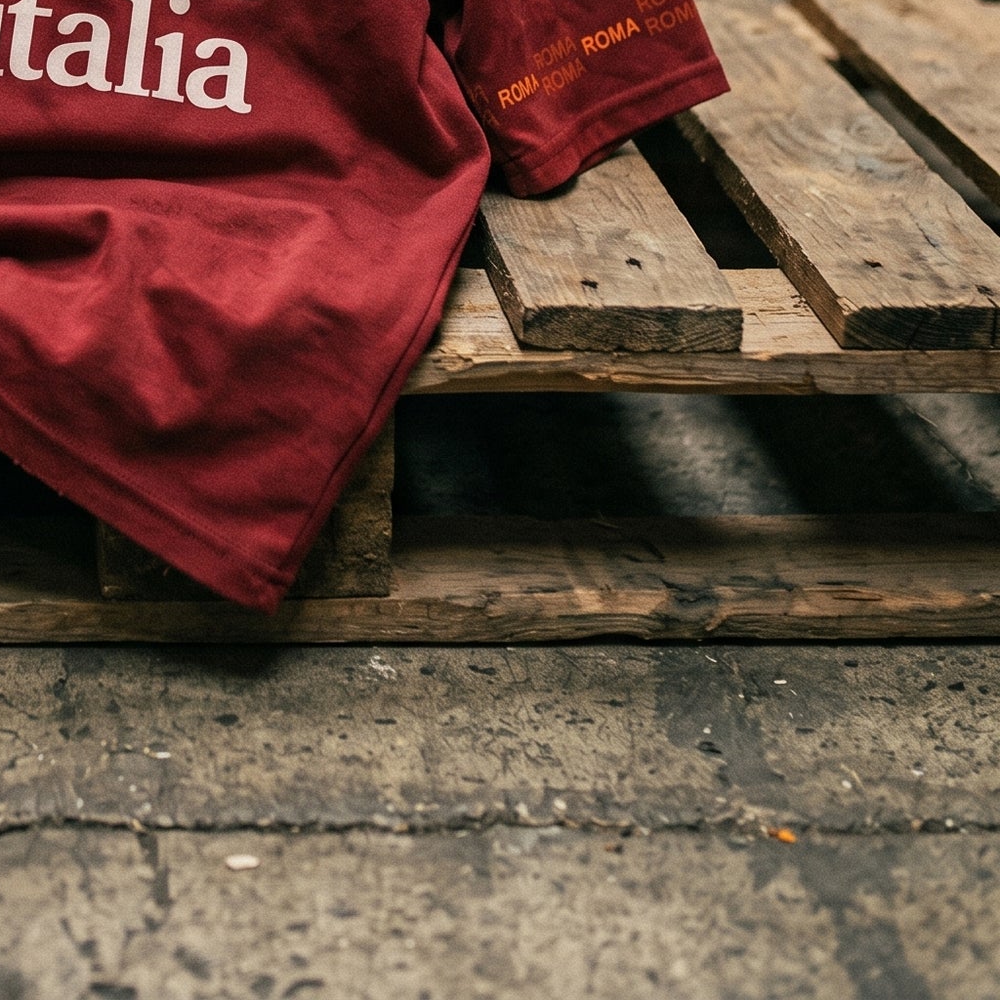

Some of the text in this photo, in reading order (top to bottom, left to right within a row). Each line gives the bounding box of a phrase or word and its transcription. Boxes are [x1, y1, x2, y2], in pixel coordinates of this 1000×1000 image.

[581, 17, 640, 56] ROMA
[644, 1, 695, 36] ROM
[533, 36, 577, 70] ROMA
[497, 73, 540, 109] ROMA
[541, 58, 587, 96] ROMA
